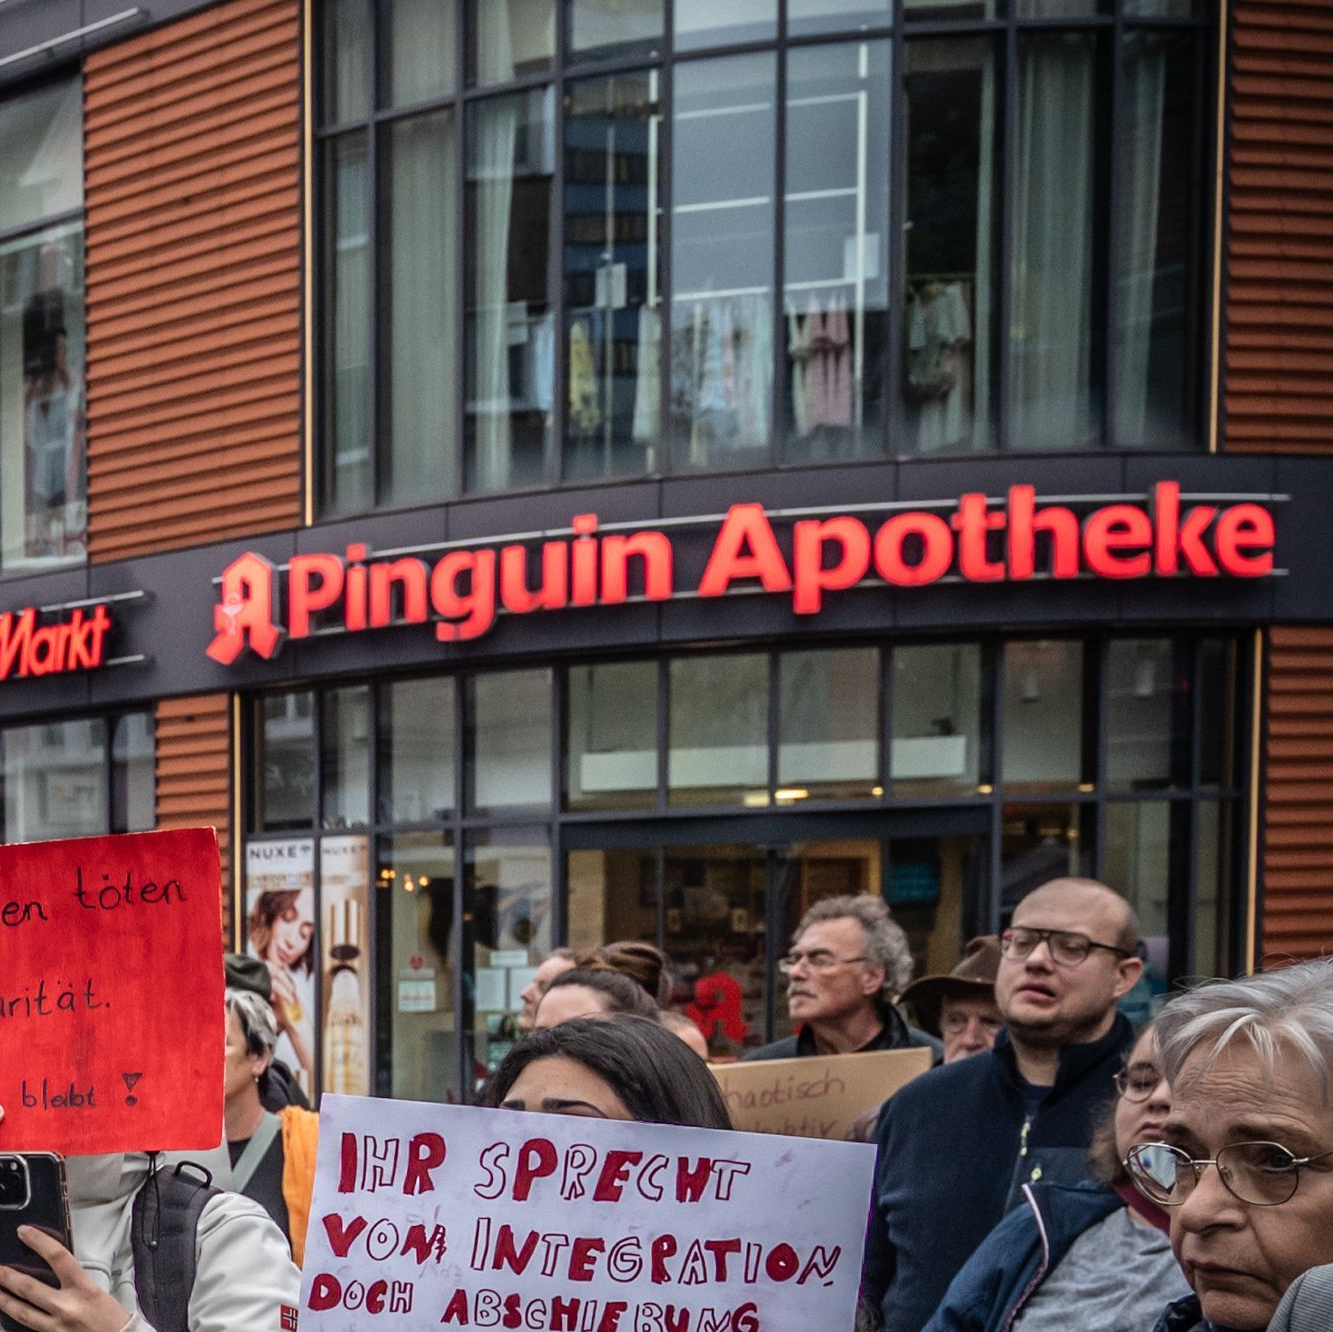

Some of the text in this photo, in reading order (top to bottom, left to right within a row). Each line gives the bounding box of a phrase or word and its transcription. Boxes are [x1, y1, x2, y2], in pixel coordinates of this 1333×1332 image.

[289, 481, 1276, 641] Pinguin Apotheke
[249, 845, 297, 859] NUXE
[73, 865, 188, 912] töten
[21, 1077, 97, 1111] bleibt
[338, 1131, 751, 1202] IHR SPRECHT
[307, 1272, 414, 1315] DOCH
